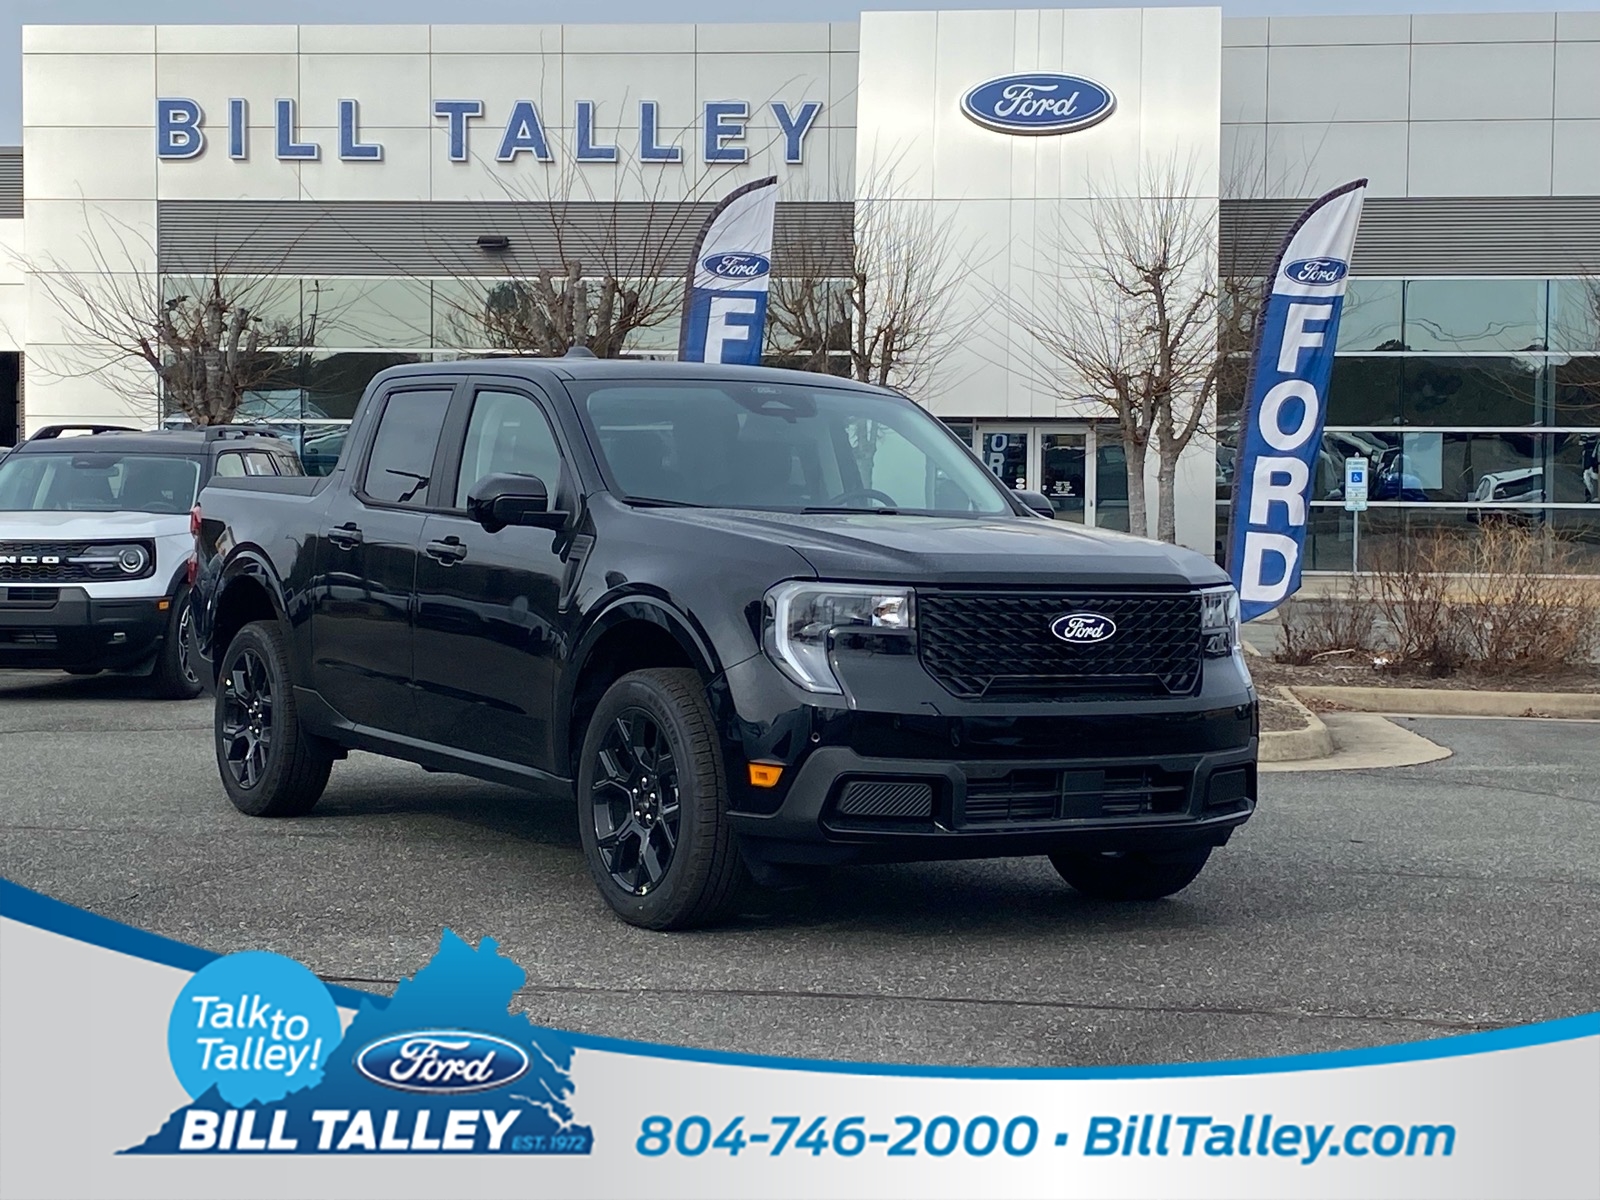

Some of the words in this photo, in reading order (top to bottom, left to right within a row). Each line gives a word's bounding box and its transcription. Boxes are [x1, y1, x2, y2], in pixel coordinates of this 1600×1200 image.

[994, 84, 1080, 117] Ford
[157, 98, 382, 162] BILL
[435, 99, 822, 164] TALLEY
[716, 255, 760, 276] Ford
[1297, 261, 1338, 282] Ford
[1240, 303, 1331, 602] FORD
[1064, 617, 1105, 638] Ford
